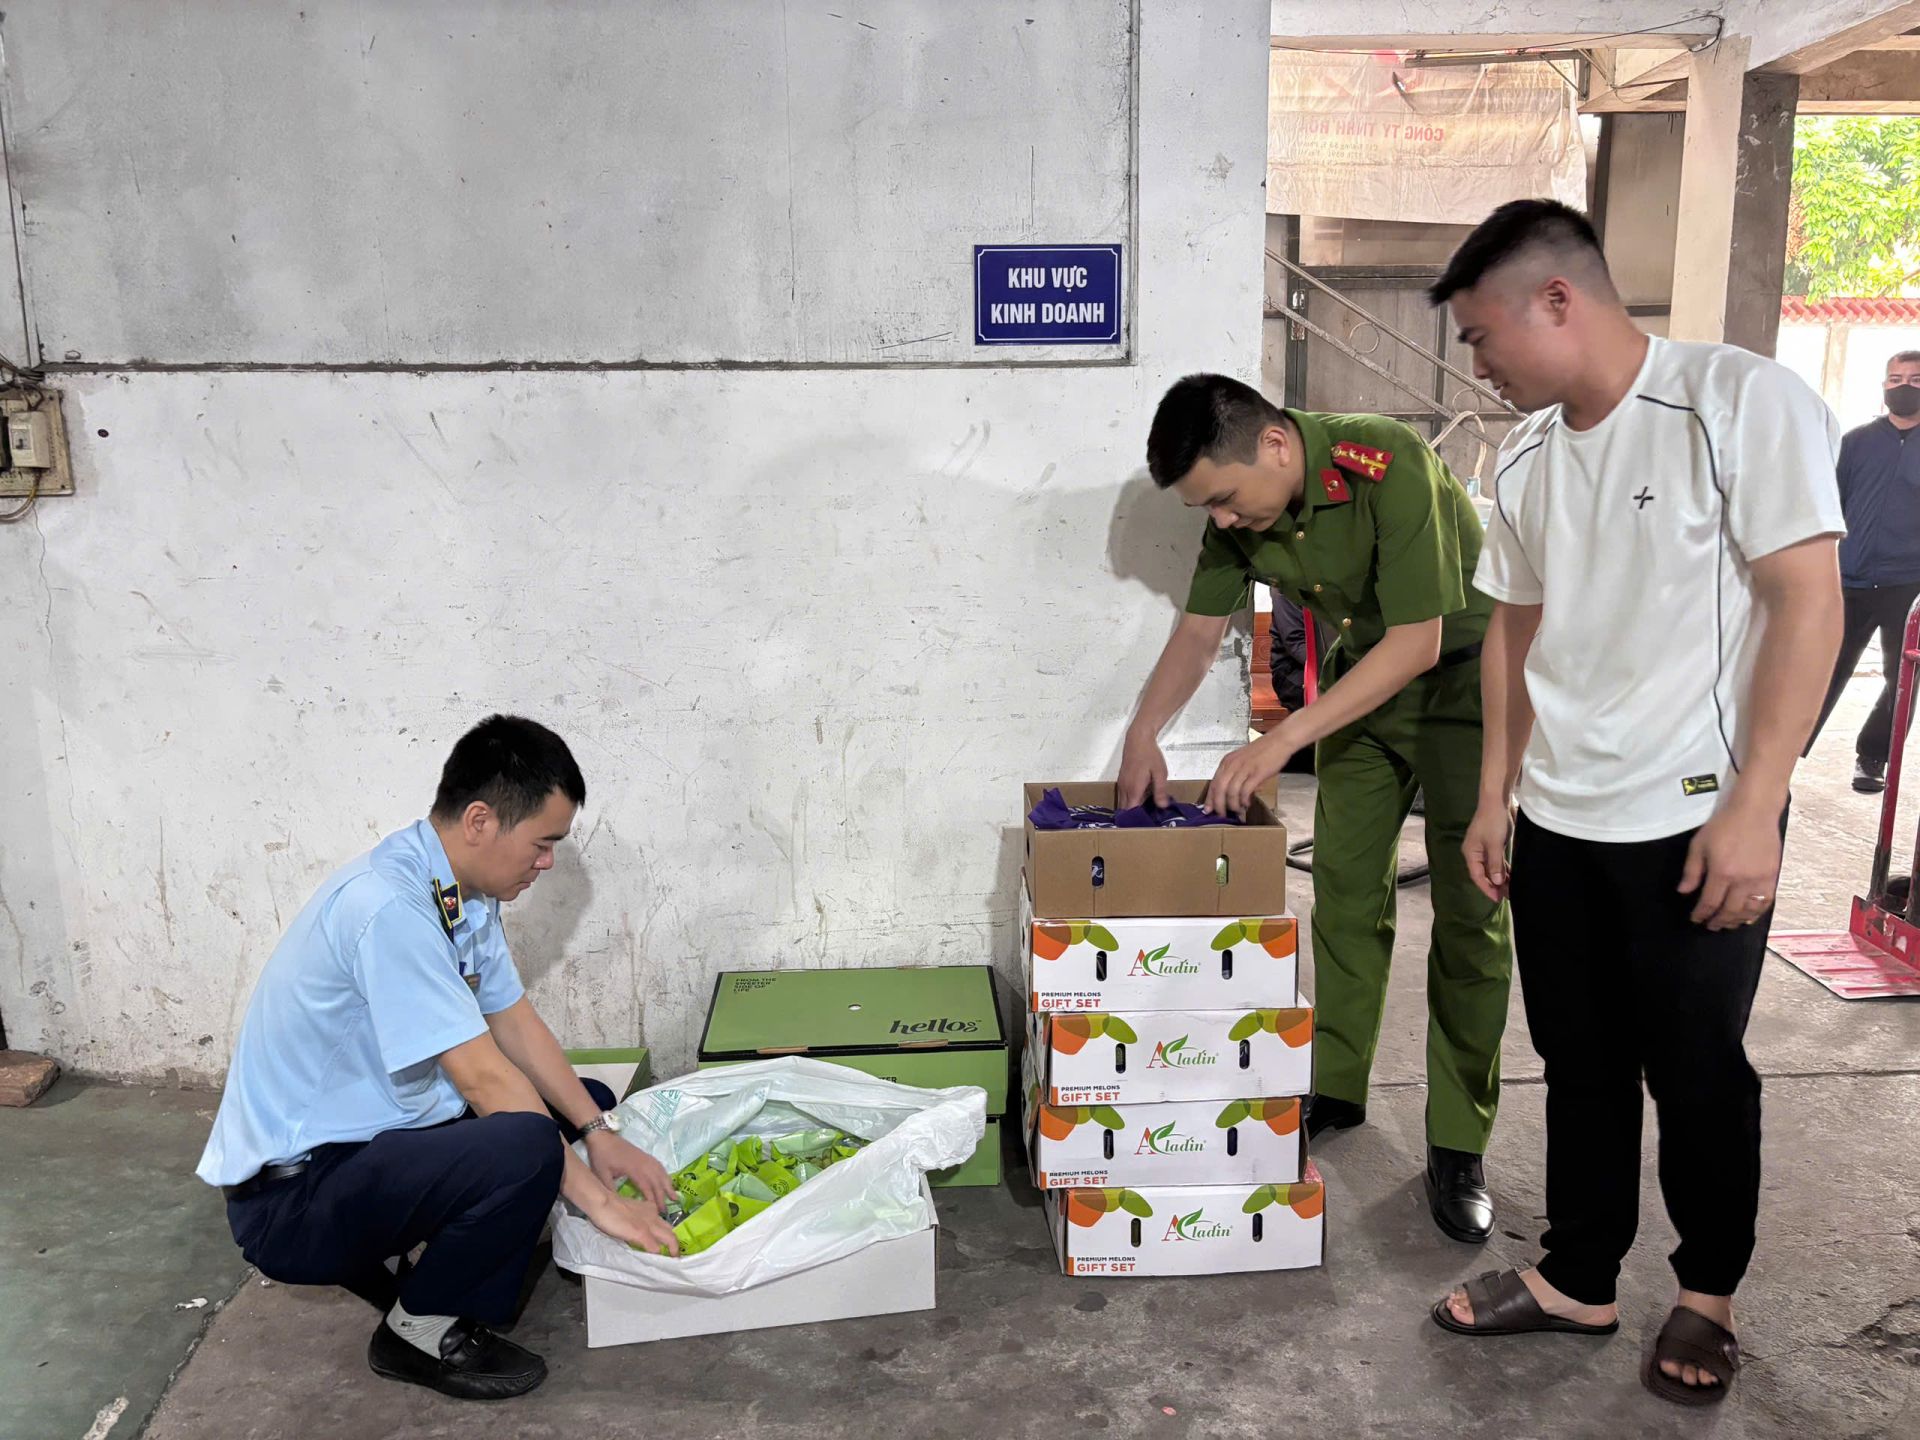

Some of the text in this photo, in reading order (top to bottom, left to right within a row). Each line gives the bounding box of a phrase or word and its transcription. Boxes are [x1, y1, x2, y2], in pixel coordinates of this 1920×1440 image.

[1008, 265, 1088, 292] KHU VỰC
[991, 302, 1105, 324] KINH DOANH
[1041, 999, 1102, 1008] GIFT SET
[1061, 1091, 1121, 1102] GIFT SET
[1049, 1176, 1108, 1186] GIFT SET
[1077, 1263, 1136, 1272] GIFT SET
